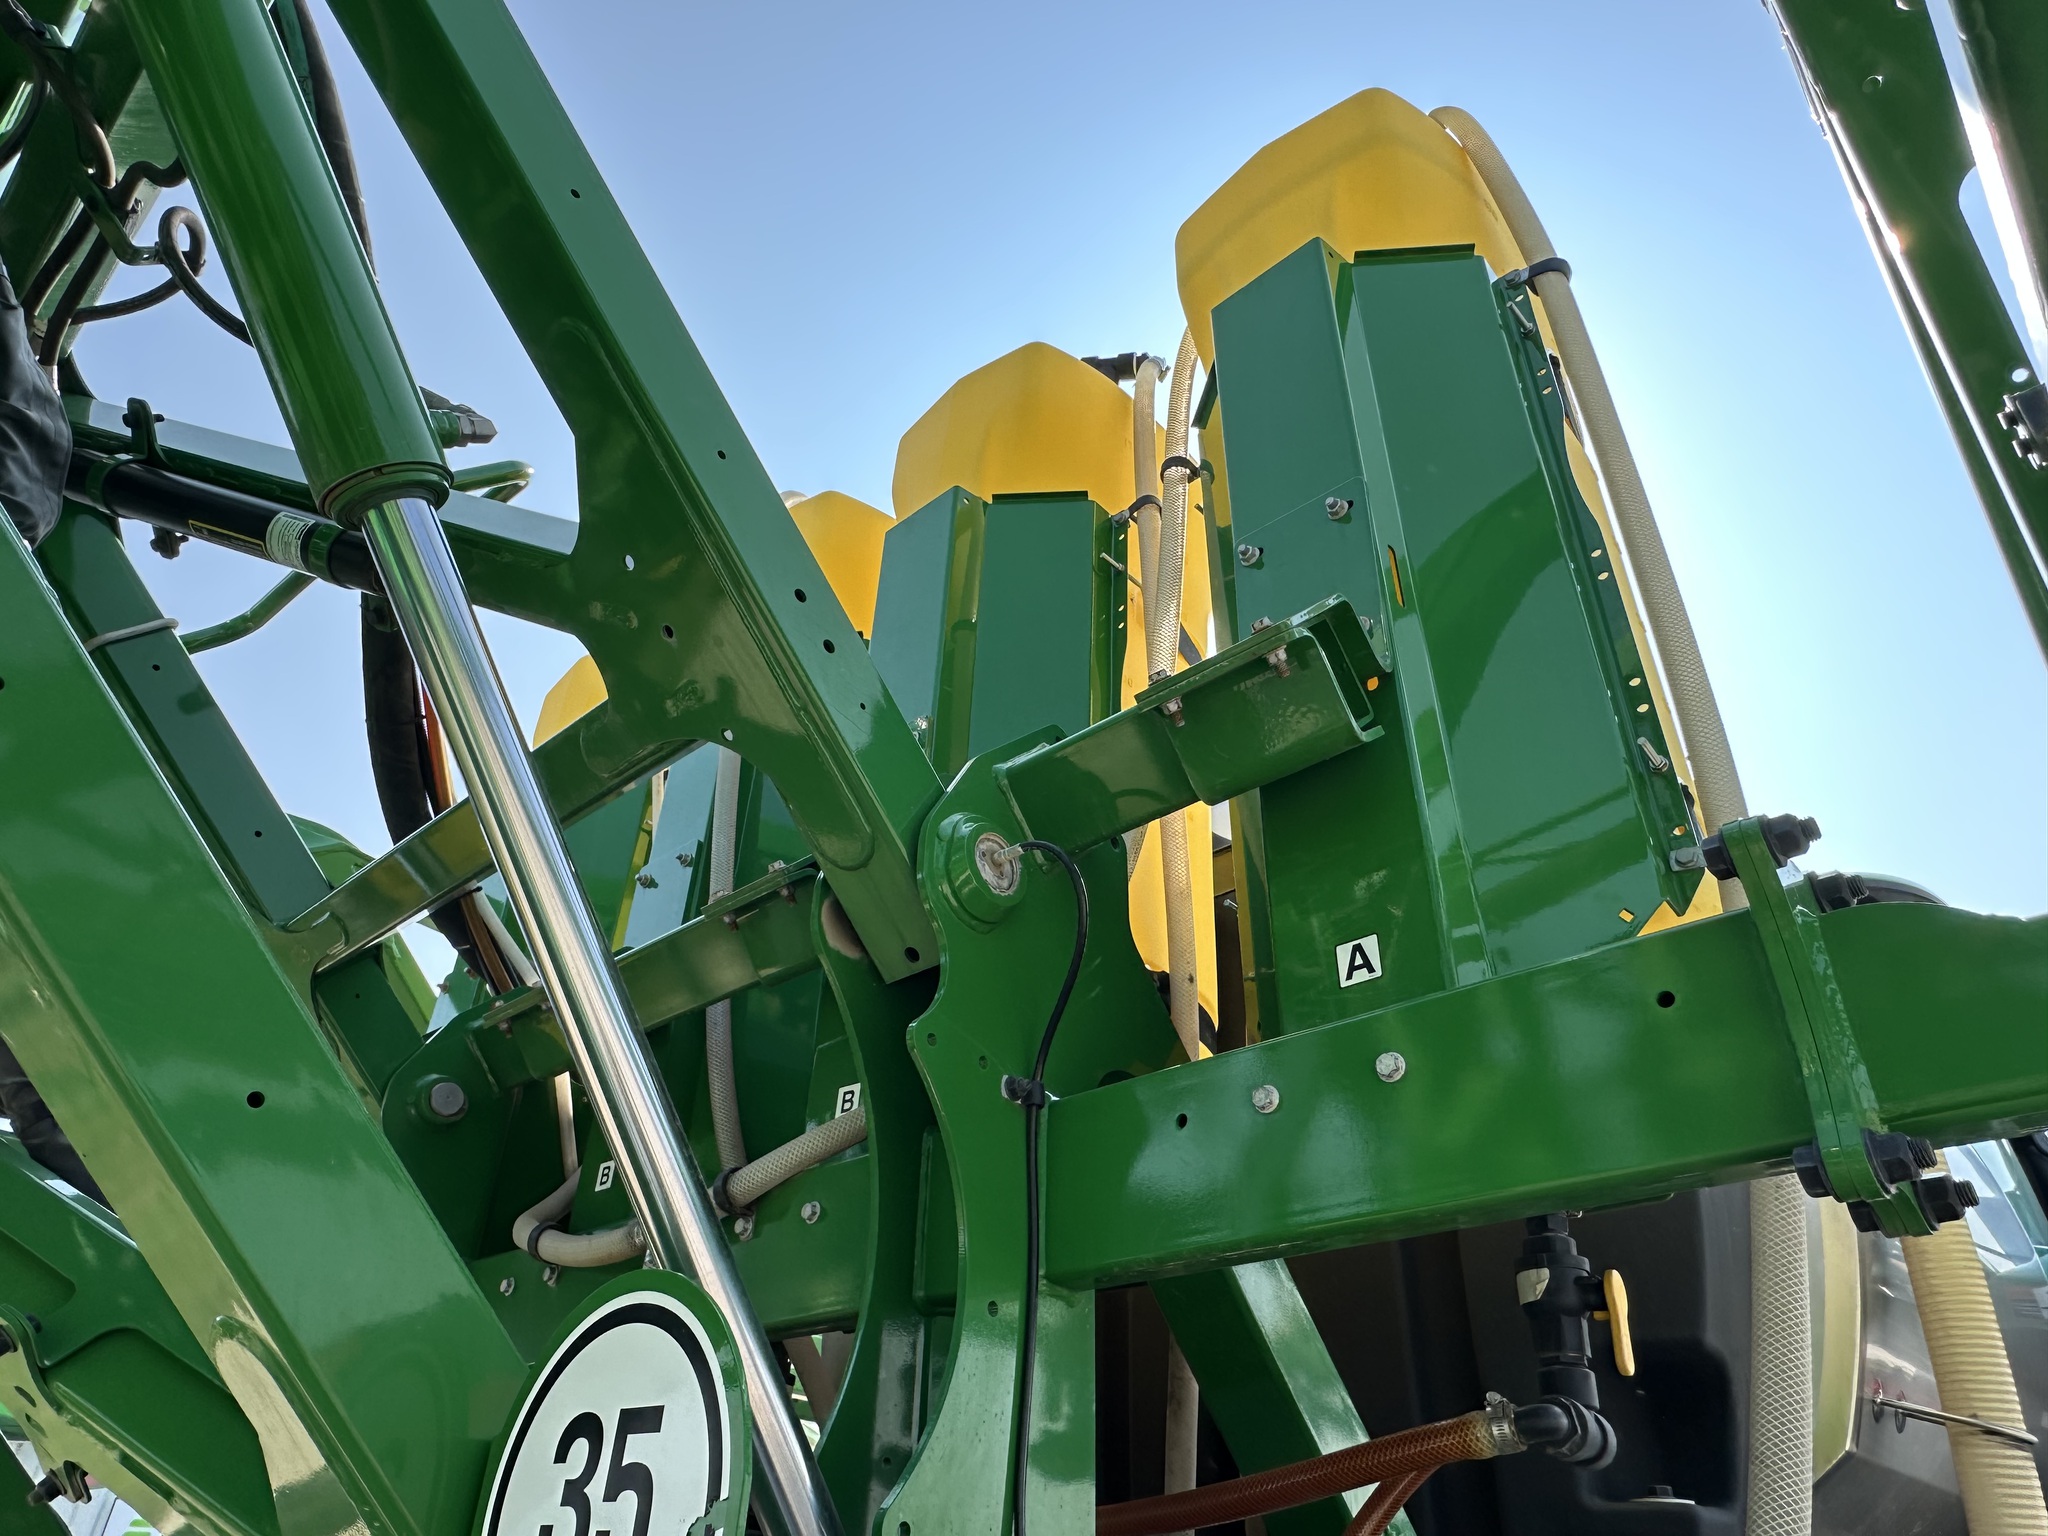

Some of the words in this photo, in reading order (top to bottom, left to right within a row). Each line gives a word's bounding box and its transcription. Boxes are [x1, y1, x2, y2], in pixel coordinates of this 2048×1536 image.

[1345, 942, 1376, 981] A
[841, 1090, 855, 1114] B
[600, 1166, 611, 1186] B
[538, 1405, 665, 1536] 35
